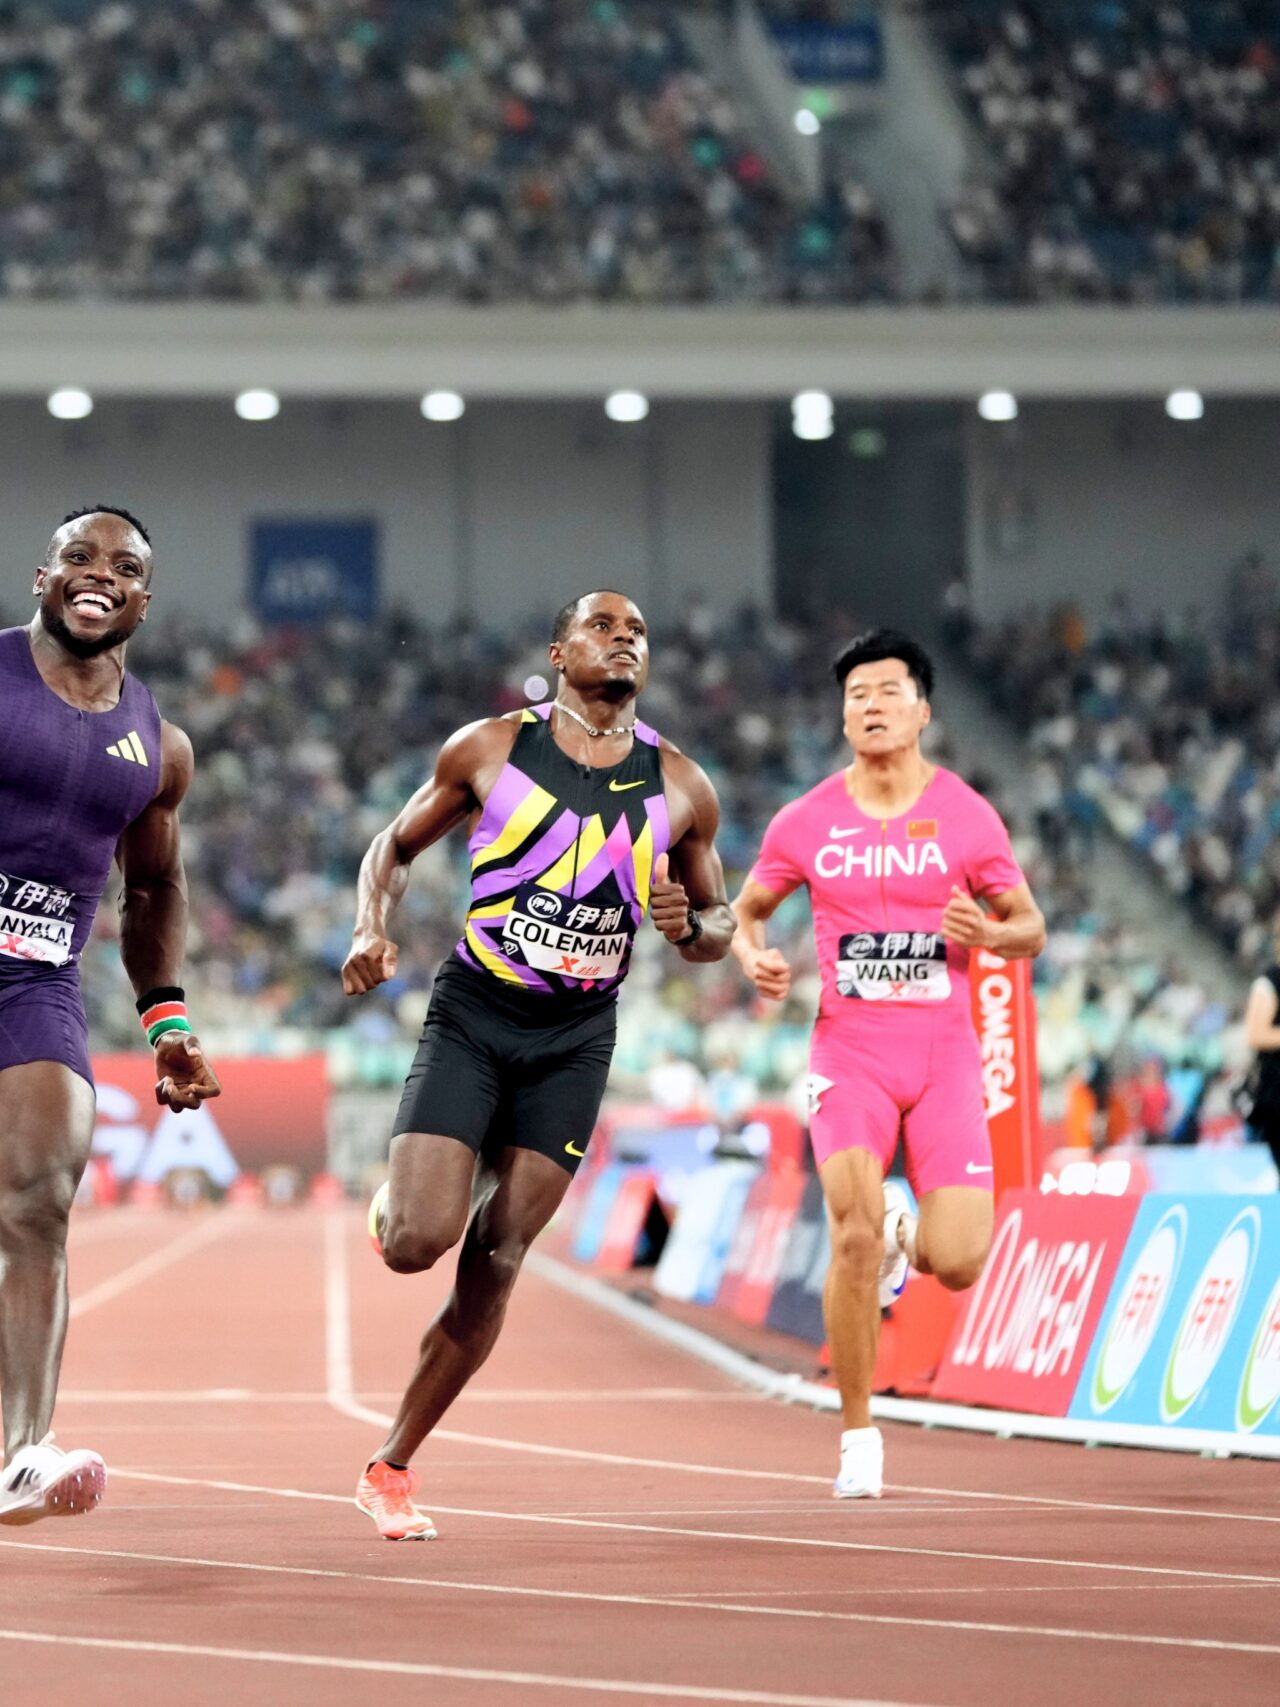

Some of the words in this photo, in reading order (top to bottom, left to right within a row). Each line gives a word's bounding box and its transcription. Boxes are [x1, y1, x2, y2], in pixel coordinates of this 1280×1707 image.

[815, 841, 948, 878] CHINA
[11, 880, 76, 917] 伊利
[565, 903, 624, 933] 伊利
[509, 917, 623, 957] COLEMAN
[881, 932, 937, 958] 伊利
[856, 963, 929, 981] WANG
[979, 974, 1017, 1120] OMEGA
[983, 1238, 1108, 1378] OMEGA
